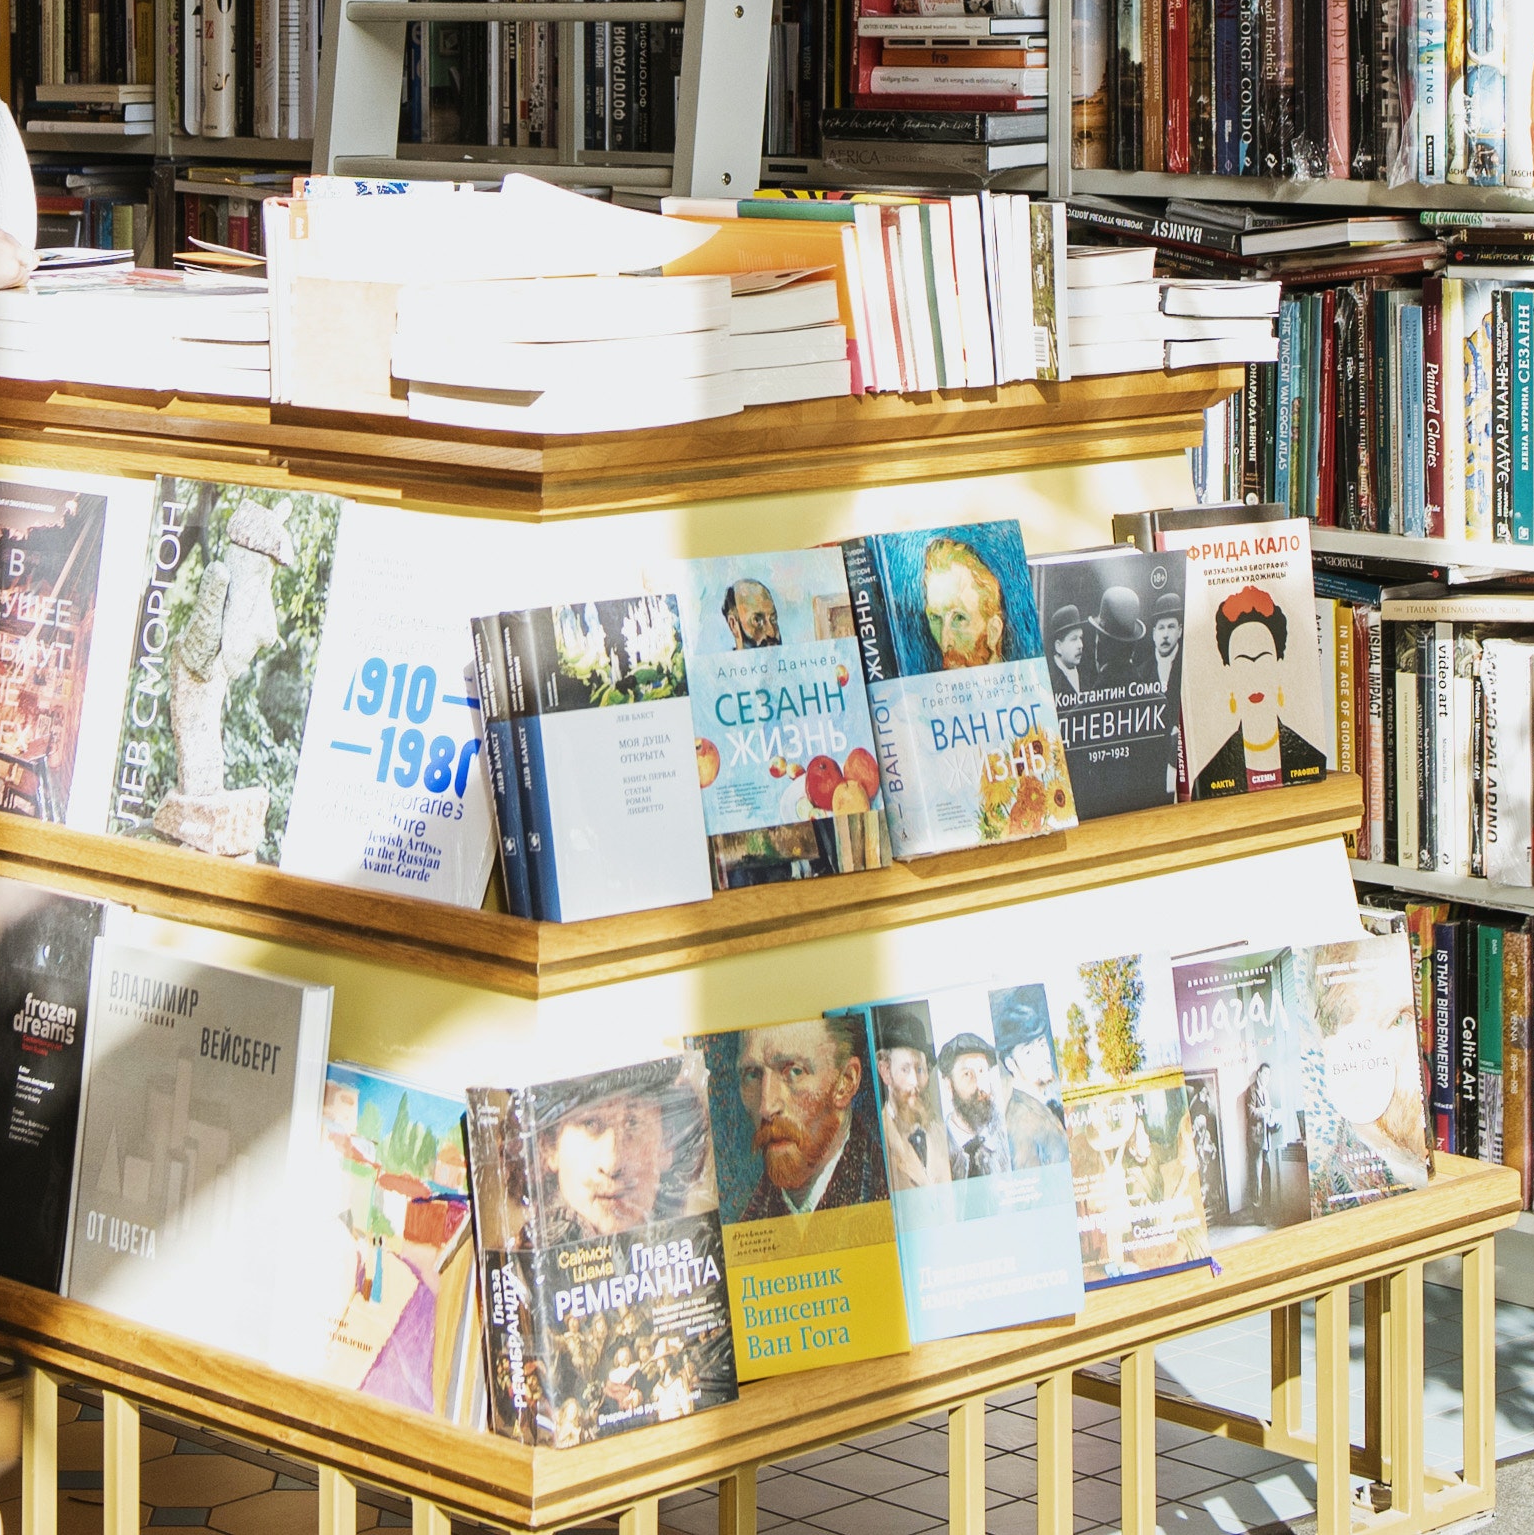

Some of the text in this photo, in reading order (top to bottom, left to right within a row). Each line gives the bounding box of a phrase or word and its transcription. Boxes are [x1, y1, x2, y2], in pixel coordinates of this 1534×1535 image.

[8, 548, 26, 578] В
[1187, 535, 1300, 562] ФРИДА КАЛО
[1153, 572, 1166, 584] 18+
[1203, 560, 1289, 576] ВИЗУАЛЬНАЯ БИОГРАФИЯ
[1207, 570, 1287, 586] ВЕЛИКОЙ ХУДОЖНИЦЫ
[855, 590, 884, 681] ЖИЗНЬ
[115, 499, 186, 830] ЛЕВ СМОРГОН
[716, 653, 838, 679] Алекс Данчев
[921, 682, 1043, 709] Грегори Уайт-Смит
[935, 671, 1025, 694] Стивен Найфи
[1054, 681, 1168, 707] Константин Сомов
[715, 680, 846, 728] СЕЗАНН
[618, 734, 671, 749] МОЯ ДУША
[726, 717, 847, 766] ЖИЗНЬ
[875, 693, 904, 792] ВАН ГОГ
[930, 703, 1041, 752] ВАН ГОГ
[1058, 704, 1166, 747] ДНЕВНИК
[621, 748, 665, 764] ОТКРЫТА
[943, 742, 1046, 790] ЖИЗНЬ
[1290, 767, 1320, 778] ГРАФИКИ
[1210, 779, 1235, 789] ФАКТЫ
[1251, 772, 1276, 783] СХЕМЫ
[360, 857, 430, 883] Avant-Garde
[377, 847, 396, 861] the
[397, 851, 441, 870] Russian
[24, 992, 77, 1026] frozen
[110, 970, 199, 1018] ВЛАДИМИР
[13, 1010, 75, 1045] dreams
[200, 1027, 281, 1075] ВЕЙСБЕРГ
[1461, 1015, 1476, 1102] Celtic Art
[86, 1210, 157, 1260] ОТ ЦВЕТА
[558, 1244, 612, 1269] Саймон
[630, 1238, 695, 1274] Глаза
[555, 1255, 721, 1322] РЕМБРАНДТА
[573, 1264, 614, 1284] Шама
[741, 1266, 843, 1302] Дневник
[743, 1293, 852, 1330] Винсента
[748, 1324, 851, 1360] Ван Гога
